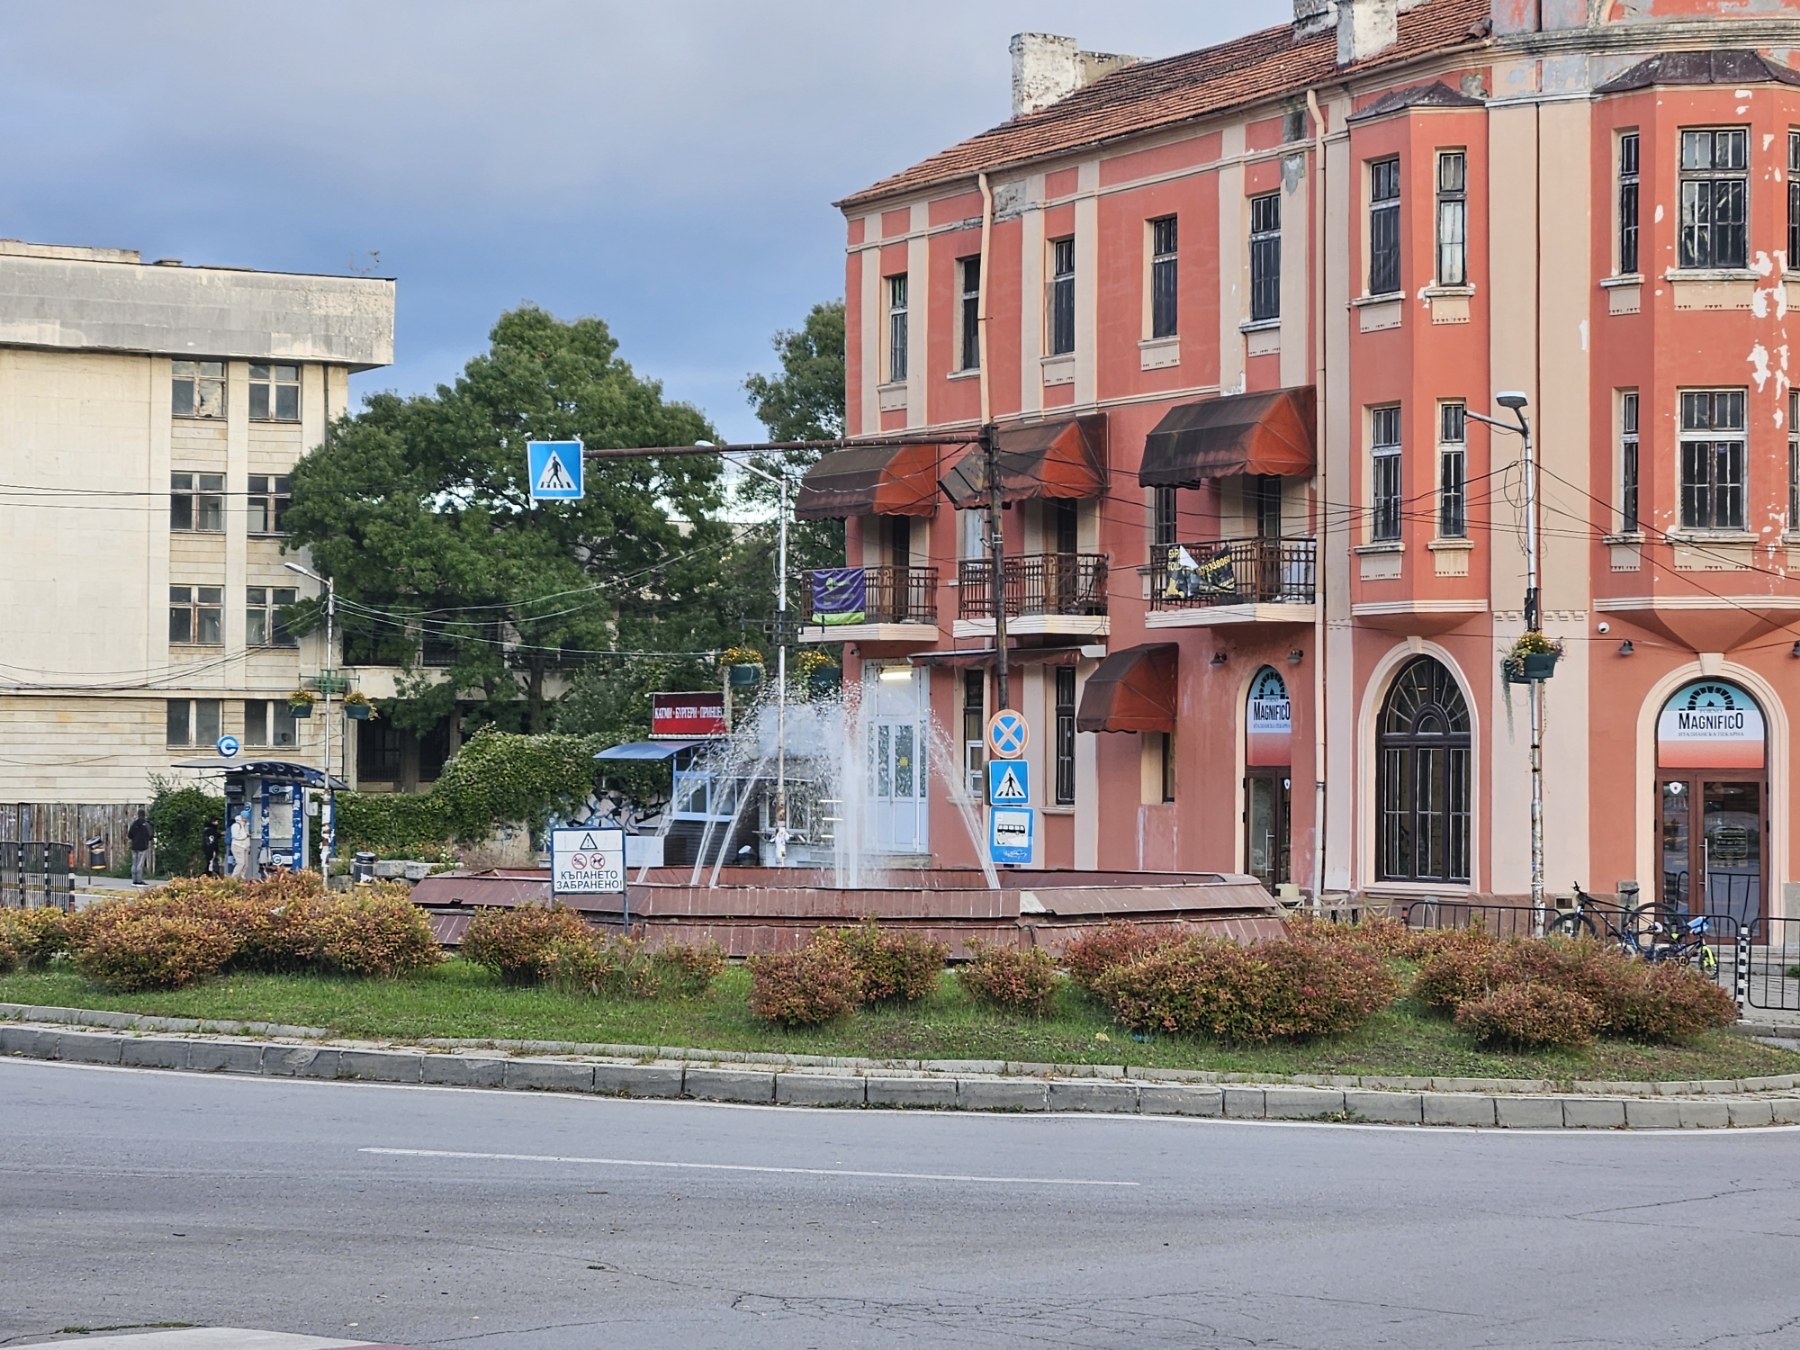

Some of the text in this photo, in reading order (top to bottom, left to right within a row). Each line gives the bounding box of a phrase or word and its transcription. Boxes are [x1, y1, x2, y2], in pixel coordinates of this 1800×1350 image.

[675, 707, 697, 718] БУРГЕРИ
[1254, 701, 1290, 720] MAGNIFICO
[1678, 712, 1744, 730] MAGNIFICO
[560, 870, 618, 880] КЪПАНЕТО
[556, 880, 623, 890] ЗАБРАНЕНО!
